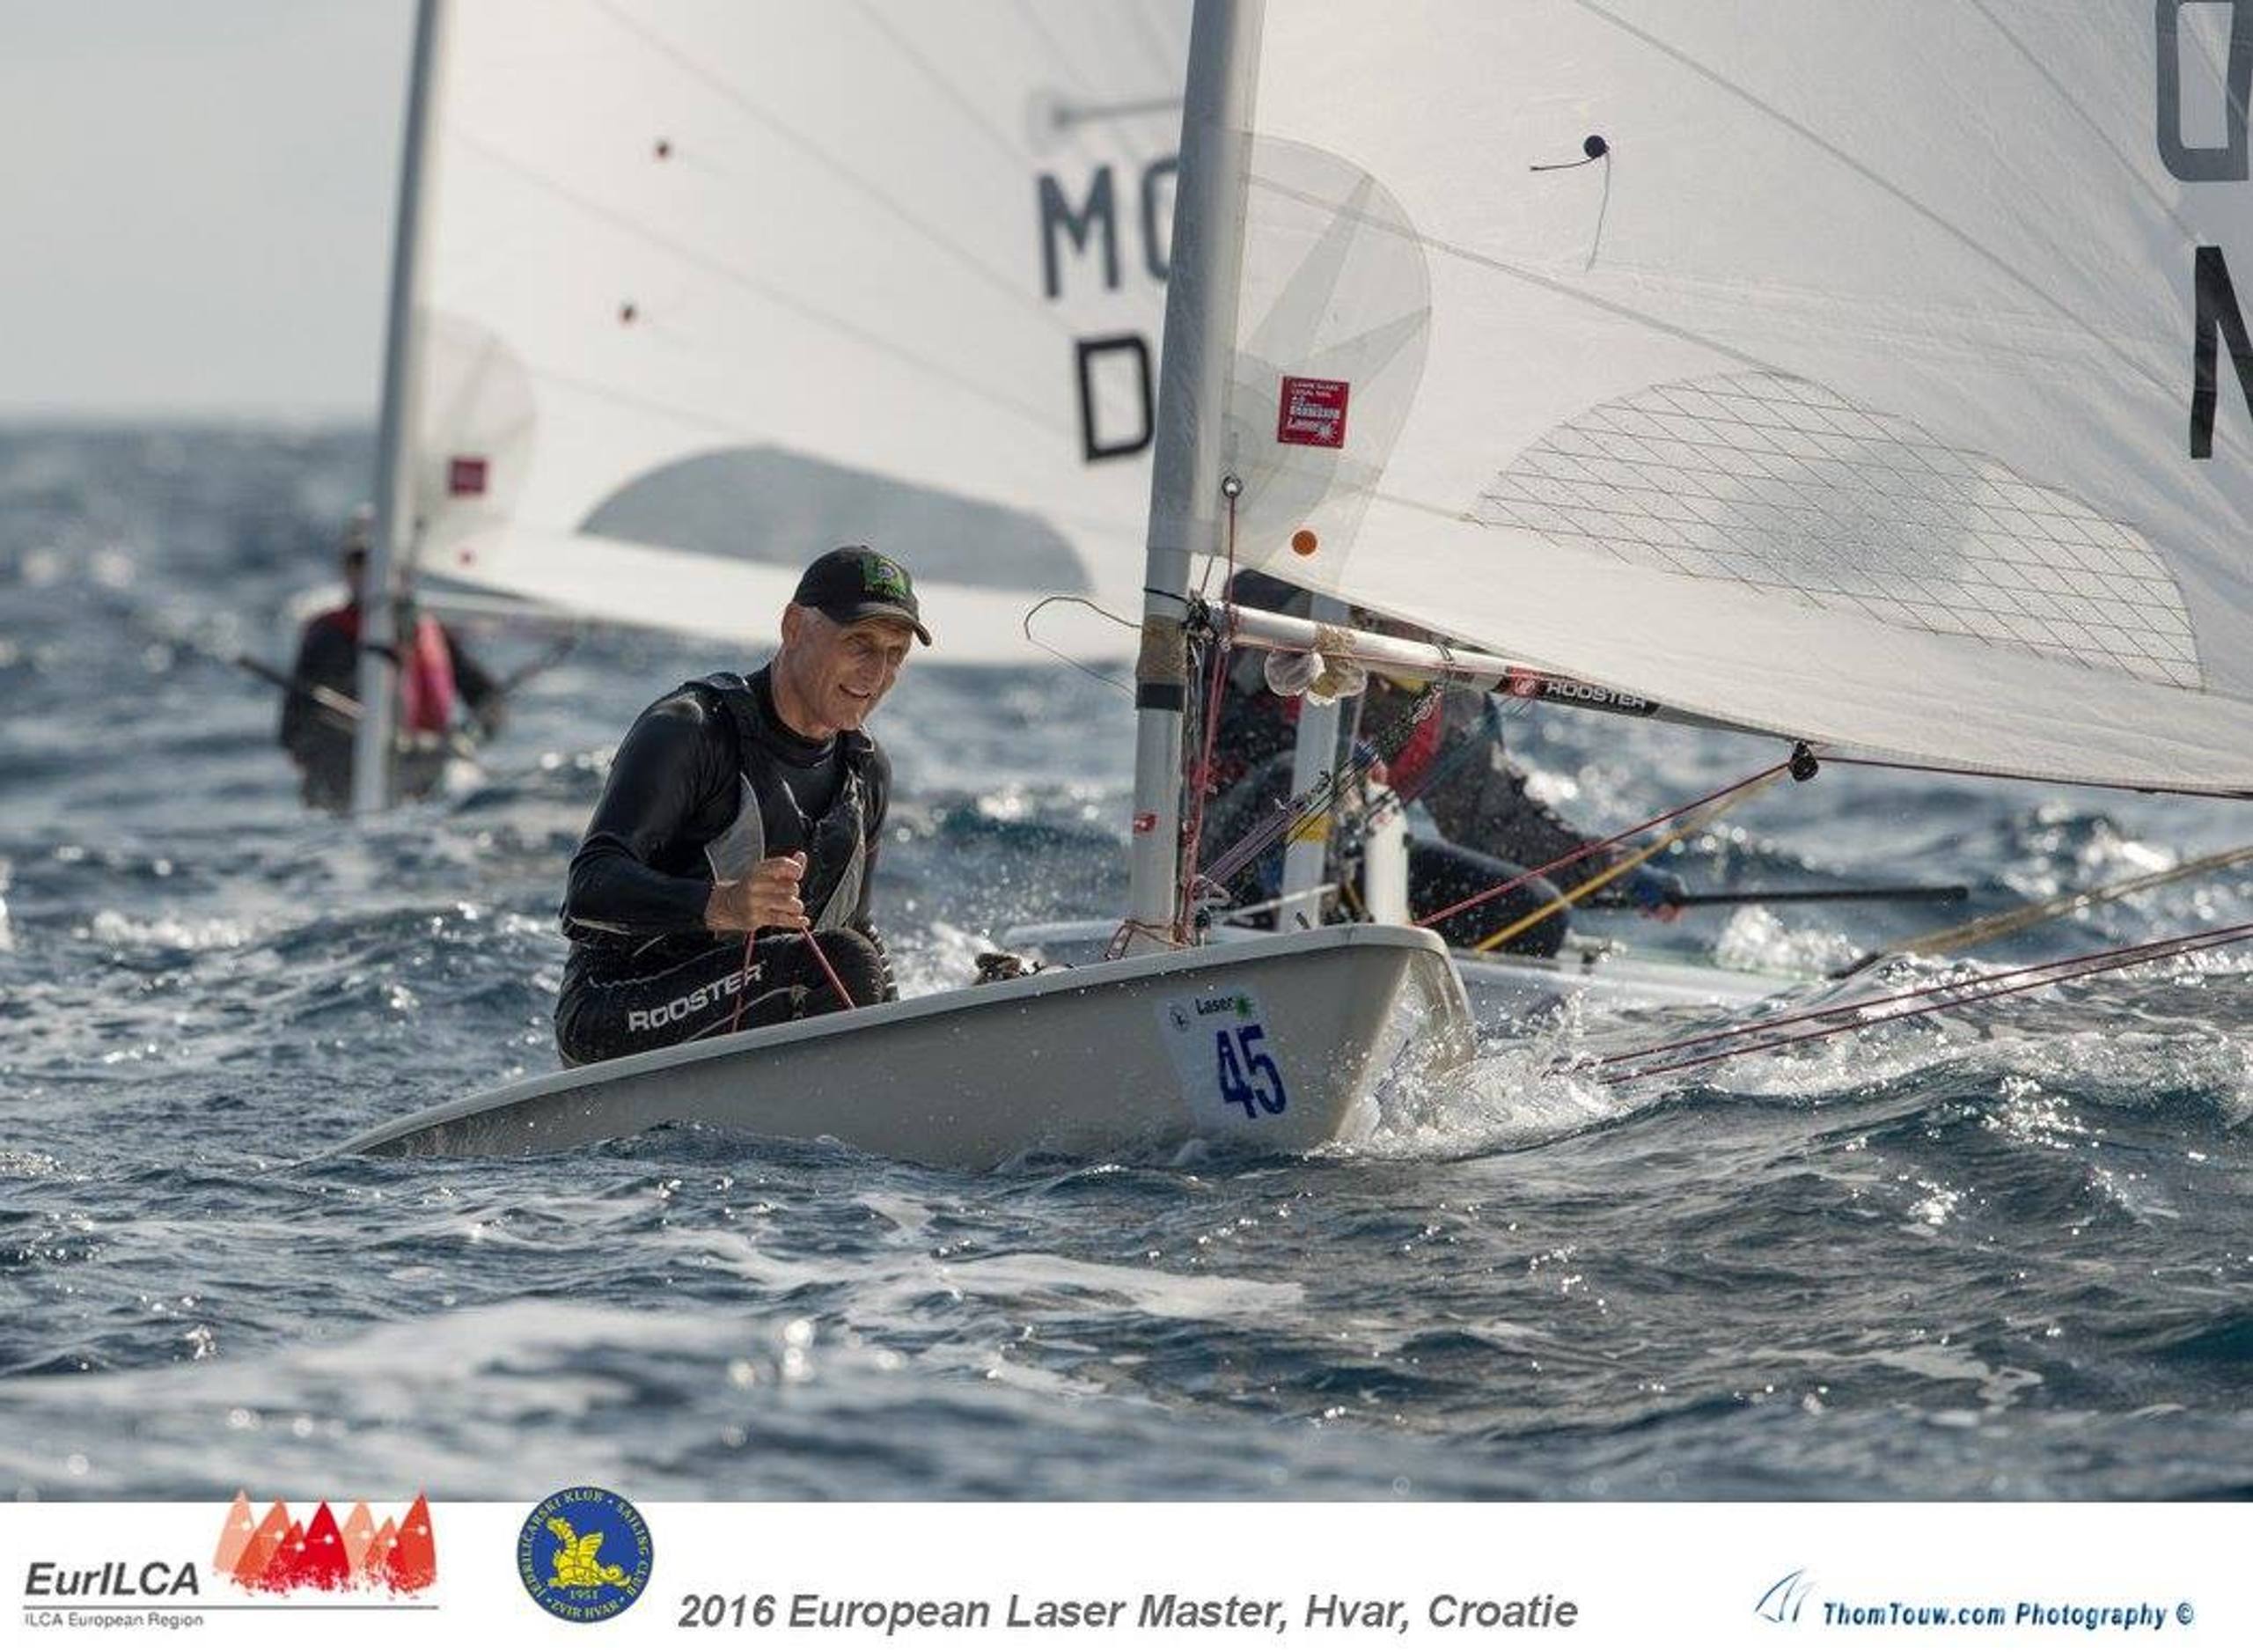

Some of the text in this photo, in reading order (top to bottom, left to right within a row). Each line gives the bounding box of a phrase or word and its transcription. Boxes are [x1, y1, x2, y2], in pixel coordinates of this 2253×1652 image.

[1076, 335, 1156, 463] D
[627, 964, 763, 1032] ROOSTER
[1195, 996, 1234, 1016] Laser
[1216, 1024, 1287, 1119] 45
